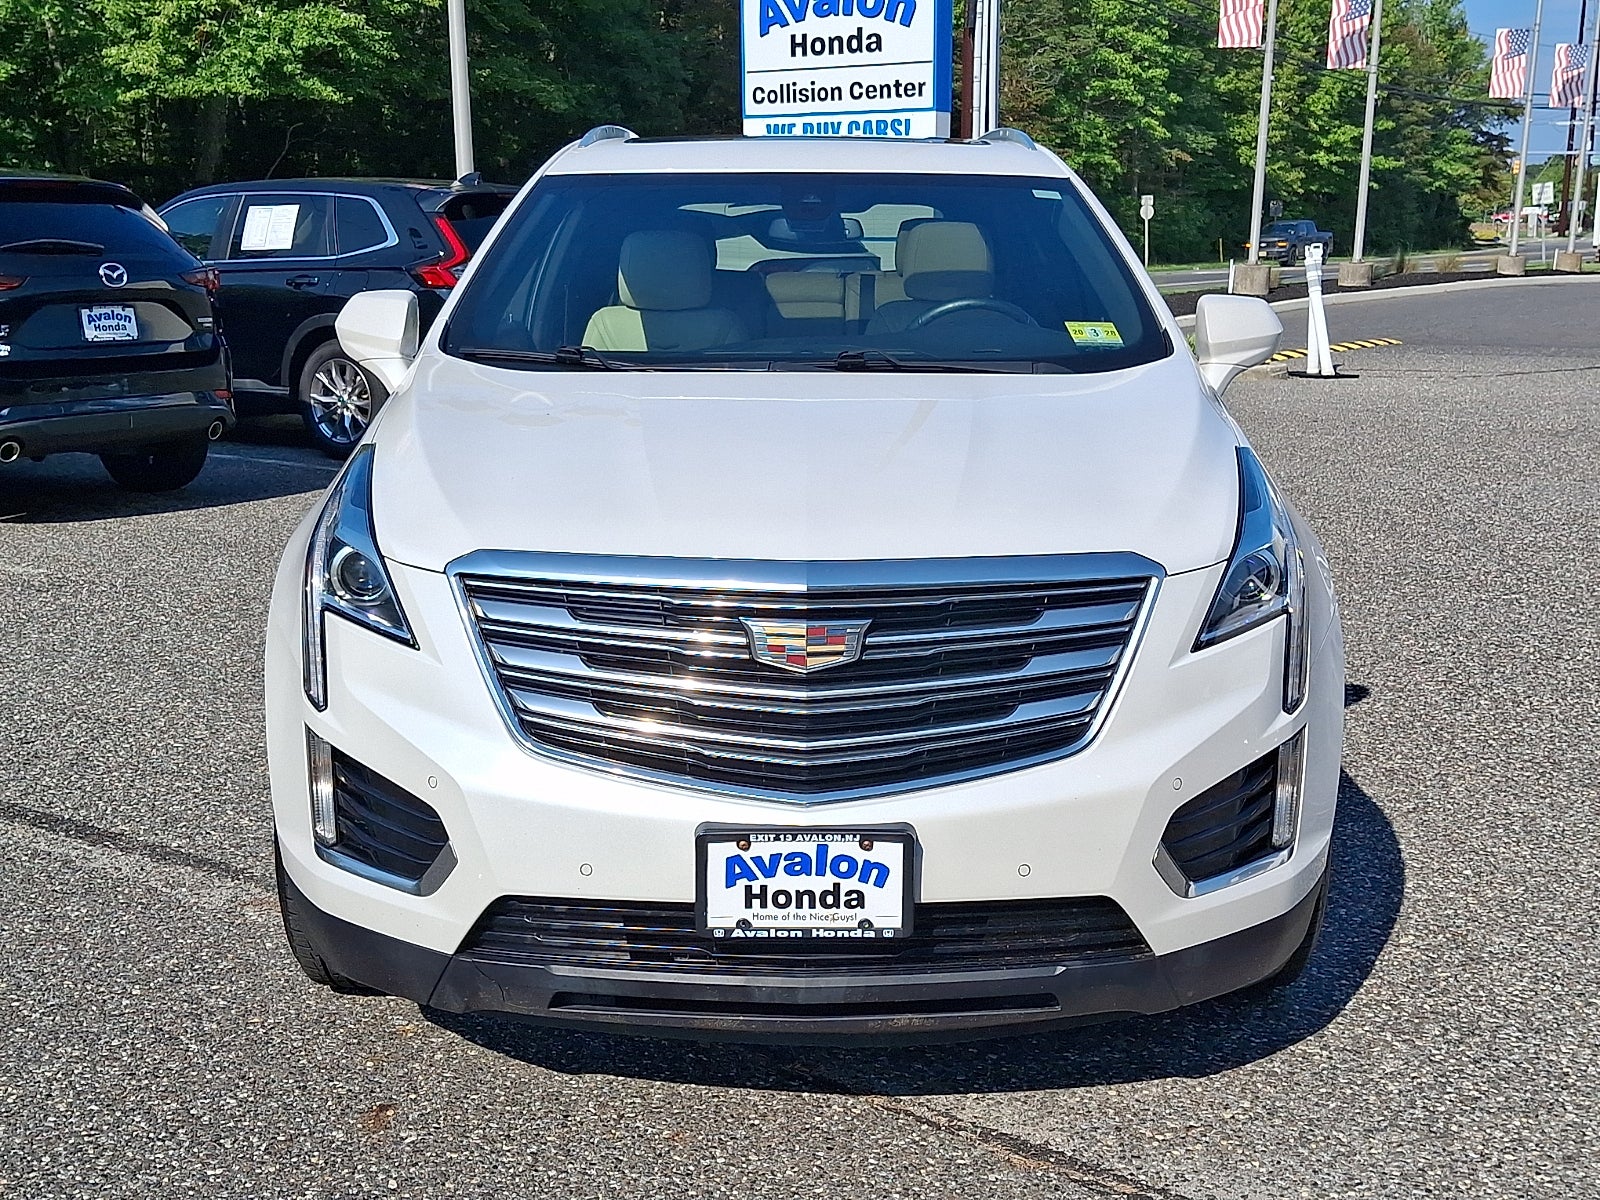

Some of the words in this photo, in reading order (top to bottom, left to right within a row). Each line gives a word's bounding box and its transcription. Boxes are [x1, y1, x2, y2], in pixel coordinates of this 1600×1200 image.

[759, 0, 917, 38] Avalon
[790, 27, 882, 57] Honda
[752, 81, 843, 105] Collision
[849, 79, 927, 100] Center
[87, 309, 132, 325] Avalon
[93, 322, 127, 331] Honda
[1090, 328, 1099, 338] 3
[749, 834, 776, 842] EXIT
[779, 834, 793, 842] 13
[725, 844, 890, 889] Avalon
[744, 882, 866, 910] Honda
[752, 912, 779, 921] Home
[781, 912, 791, 921] of
[793, 912, 807, 921] the
[809, 912, 830, 921] Nice
[832, 912, 857, 923] Guys!
[730, 928, 803, 938] Avalon
[811, 928, 876, 938] Honda
